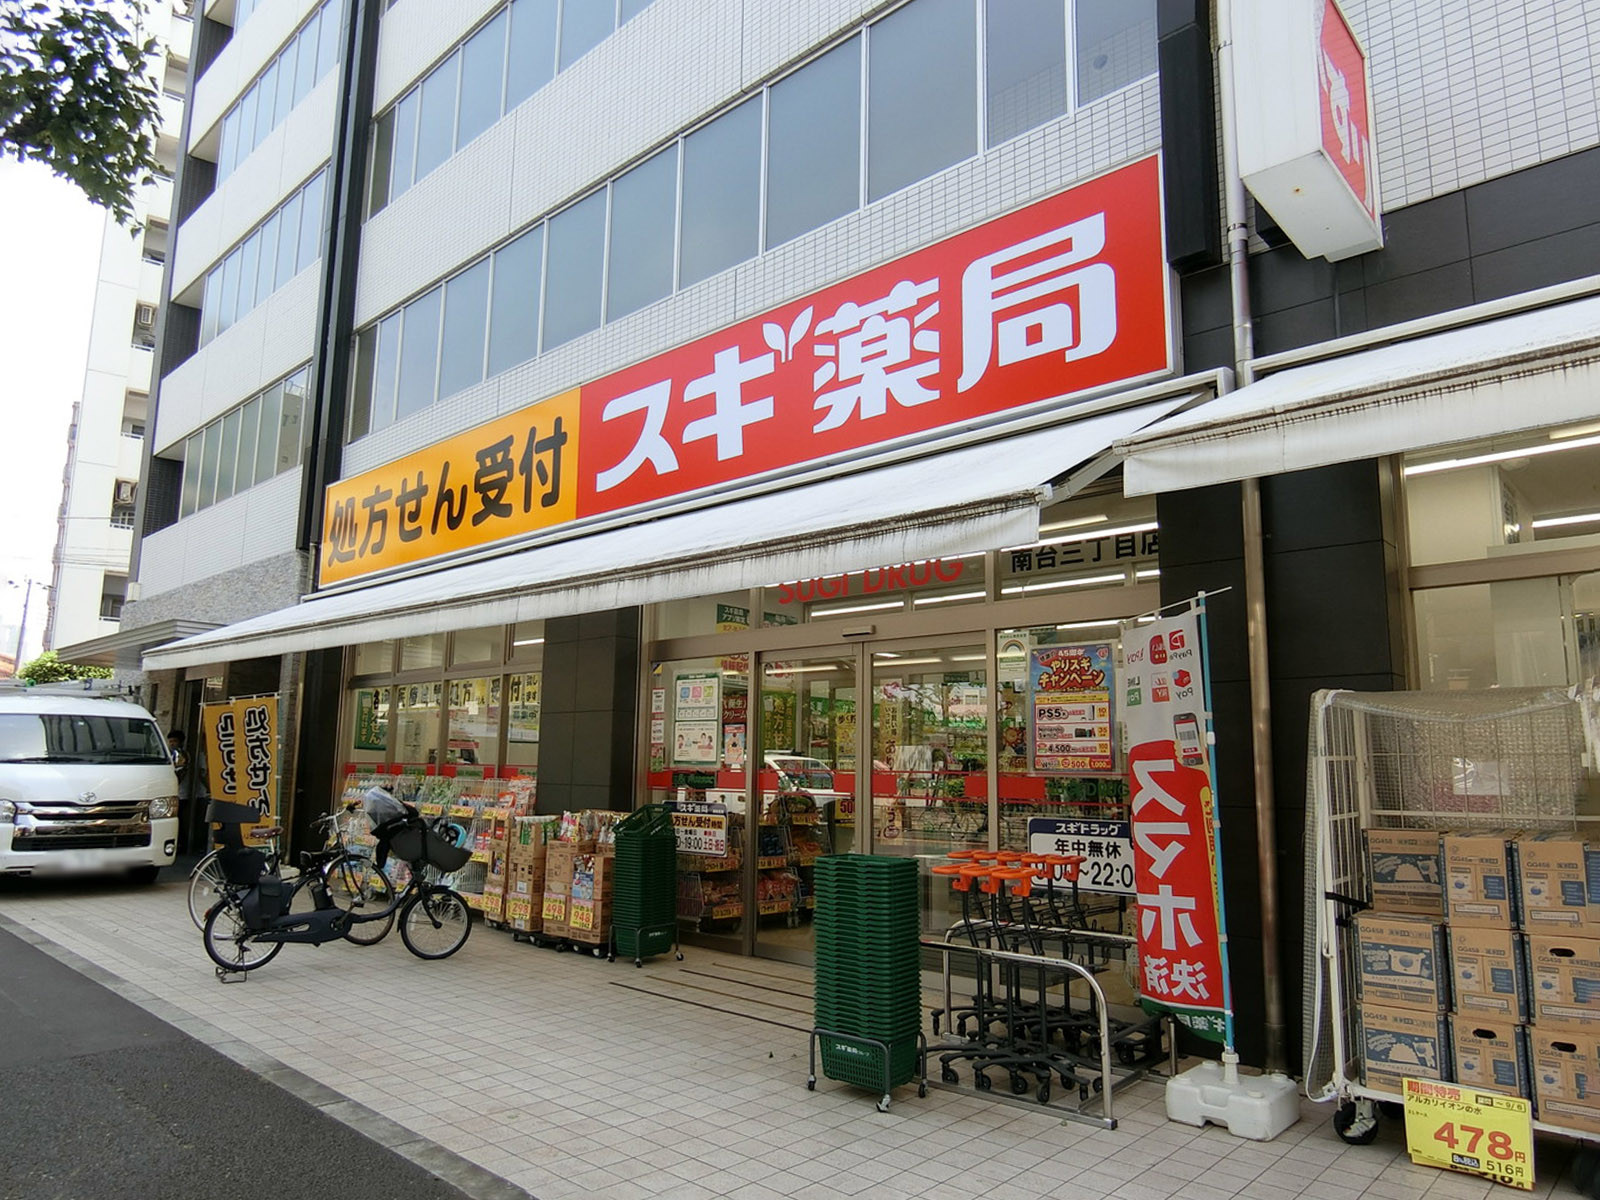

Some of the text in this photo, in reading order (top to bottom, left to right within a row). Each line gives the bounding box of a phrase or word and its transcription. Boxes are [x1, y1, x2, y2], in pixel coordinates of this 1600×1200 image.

[596, 211, 1116, 493] スギ薬局
[328, 416, 568, 568] 処方せん受付
[1010, 529, 1160, 574] 南台三丁目店
[778, 559, 964, 605] SUGI DRUG
[1037, 669, 1106, 688] キャンペーン
[1055, 822, 1121, 836] スギドラッグ
[1054, 838, 1122, 859] 年中無休
[512, 902, 529, 914] 298
[573, 911, 592, 923] 948
[1407, 1080, 1461, 1102] 期間特売
[1406, 1094, 1483, 1116] アルカリイオンの水
